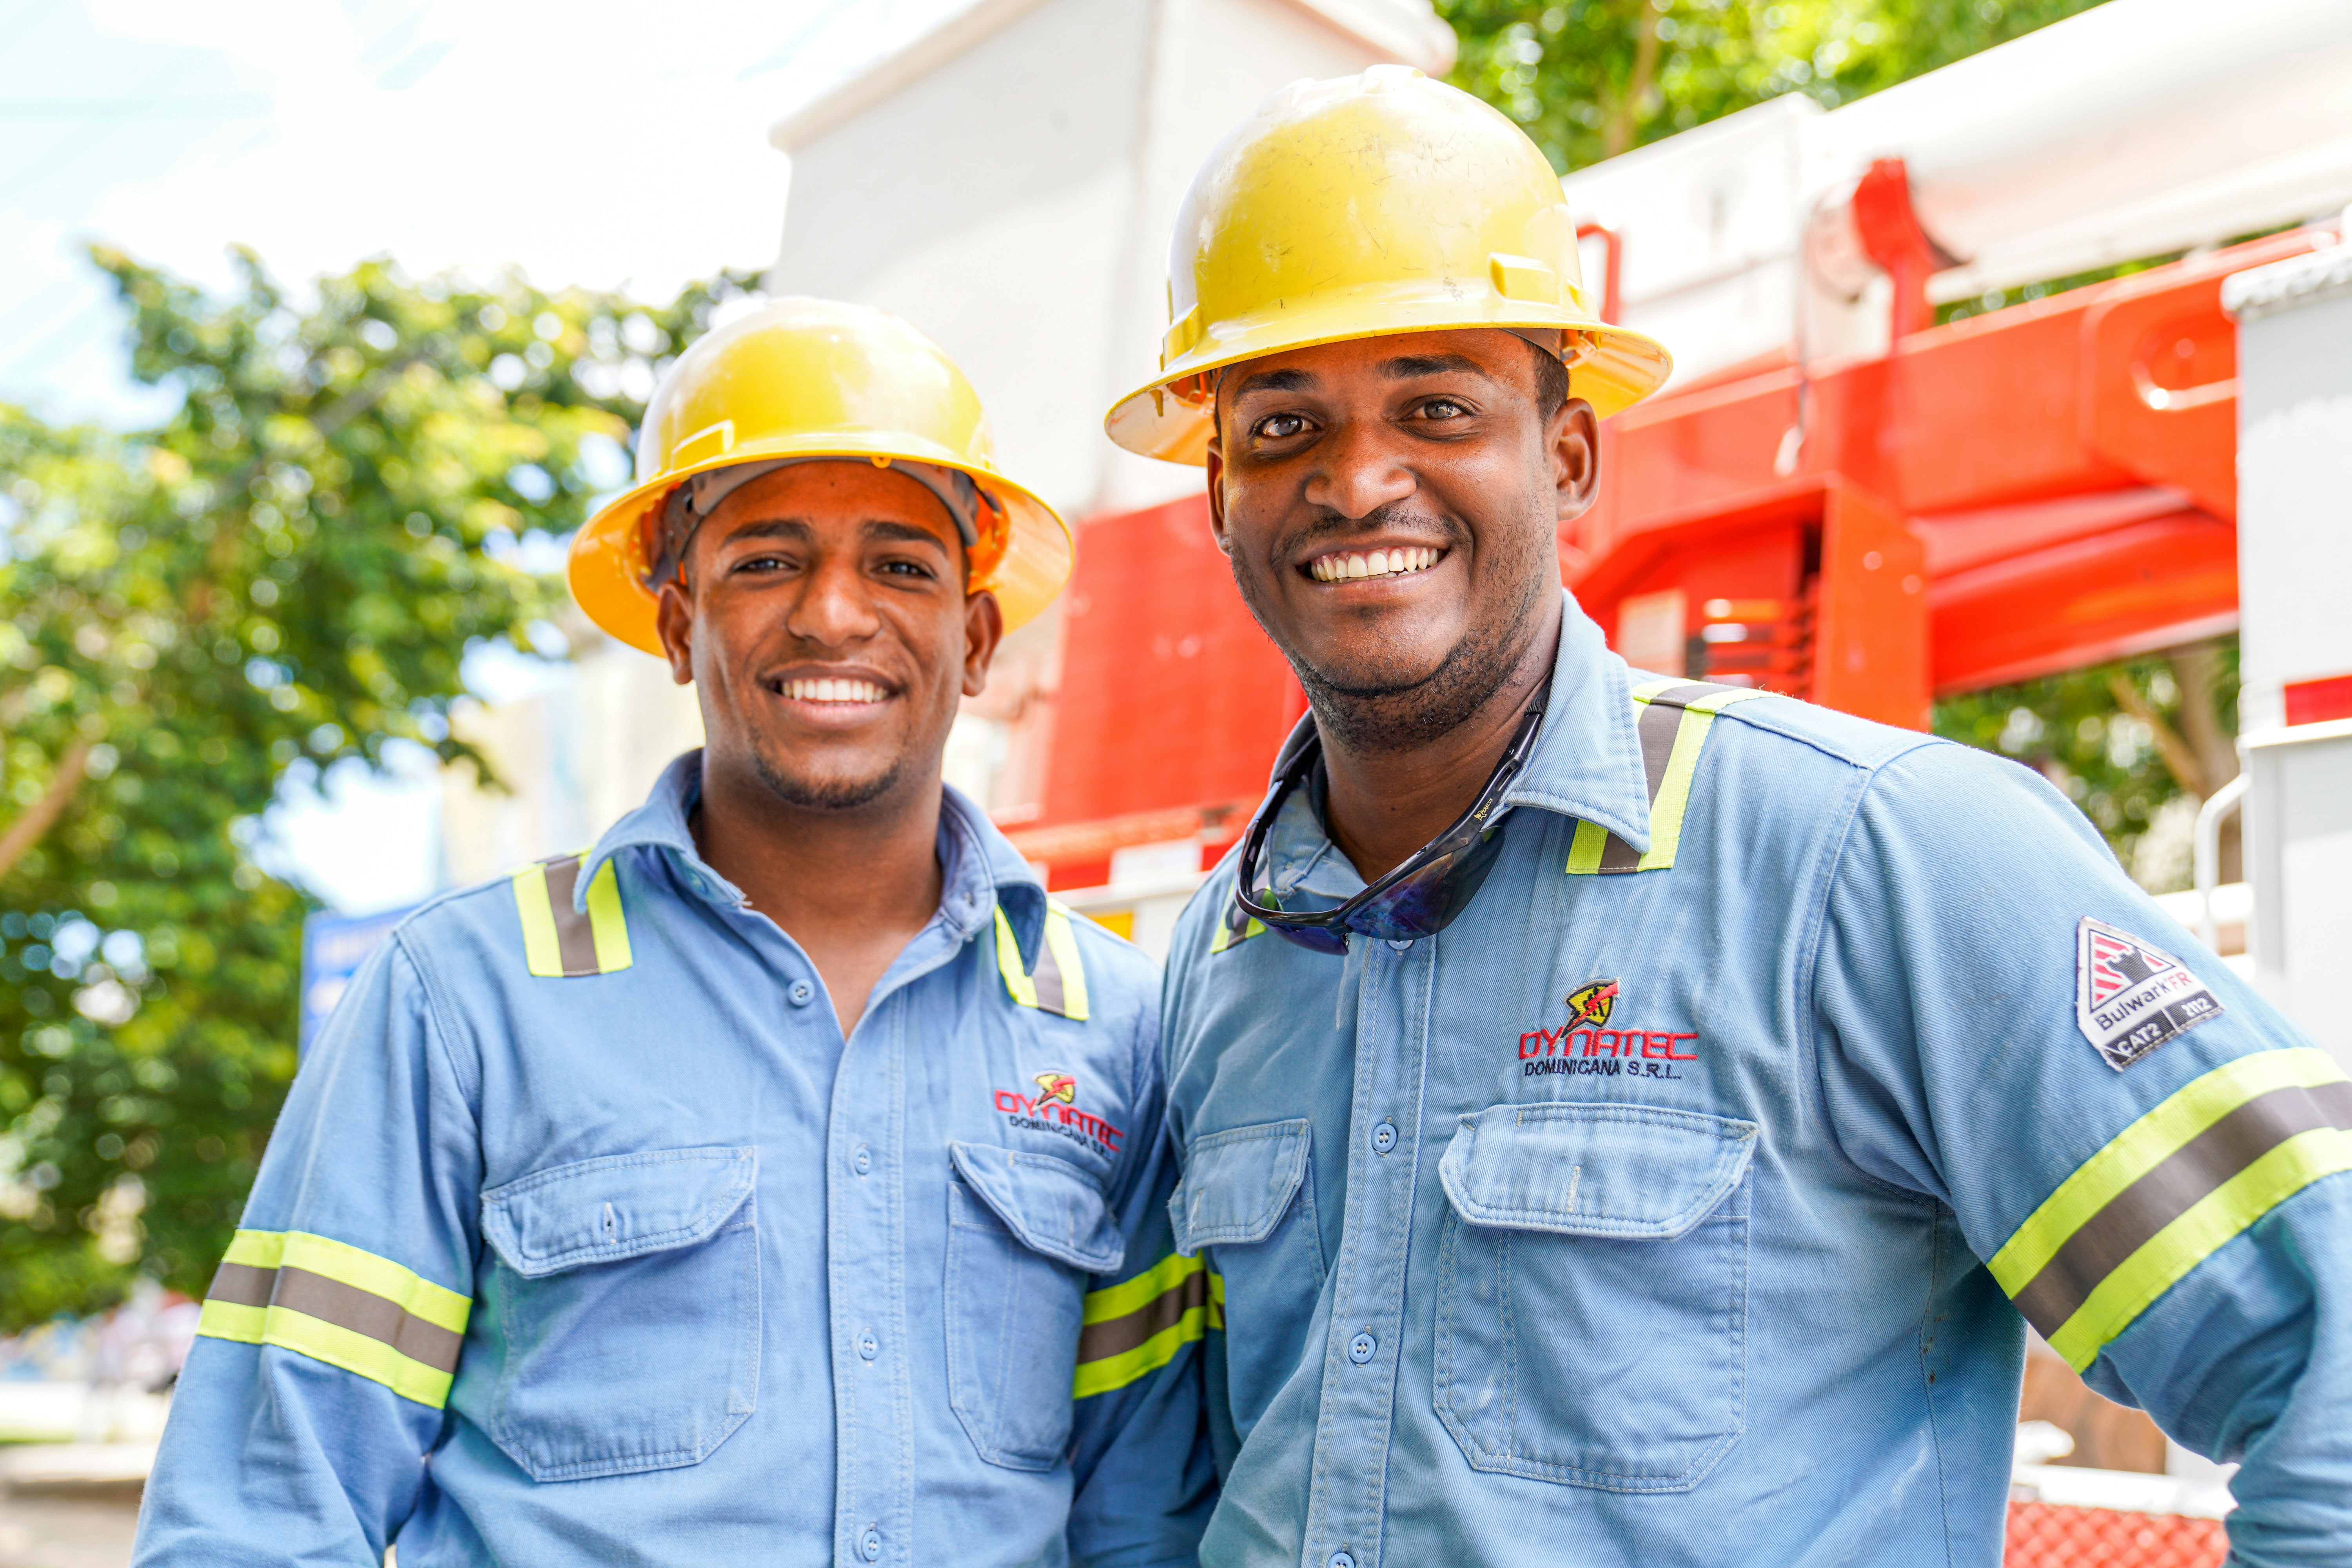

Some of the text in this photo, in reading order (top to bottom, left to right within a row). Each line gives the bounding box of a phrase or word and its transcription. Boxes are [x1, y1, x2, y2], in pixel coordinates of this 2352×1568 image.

[2095, 981, 2171, 1031] Bulwark
[2181, 997, 2212, 1018] 2112
[1519, 1025, 1699, 1060] DYNATEC
[2117, 1023, 2162, 1054] CAT2
[1524, 1059, 1681, 1080] DOMINICANA S.R.L.
